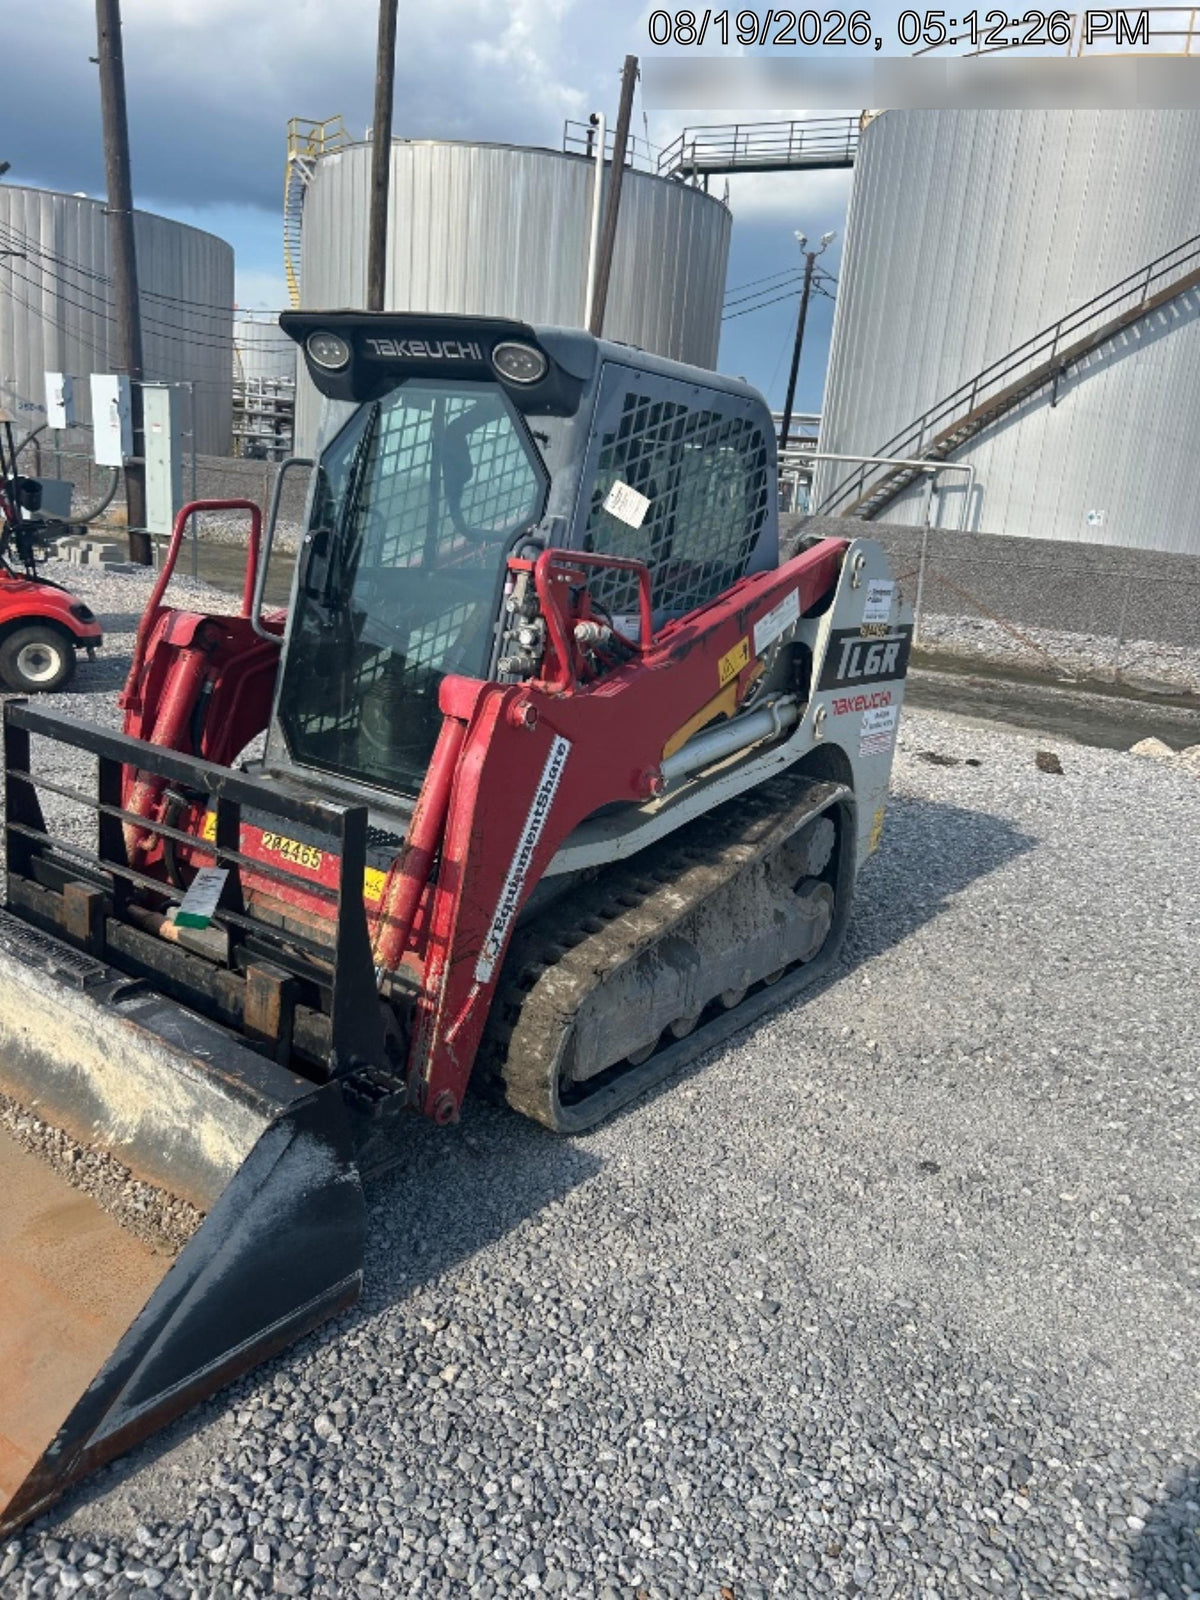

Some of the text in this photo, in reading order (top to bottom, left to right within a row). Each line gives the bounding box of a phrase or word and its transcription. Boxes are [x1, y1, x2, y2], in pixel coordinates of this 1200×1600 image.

[366, 339, 482, 360] TAKEUCHI
[837, 633, 907, 680] TL6R
[493, 742, 566, 932] EquipmentShare
